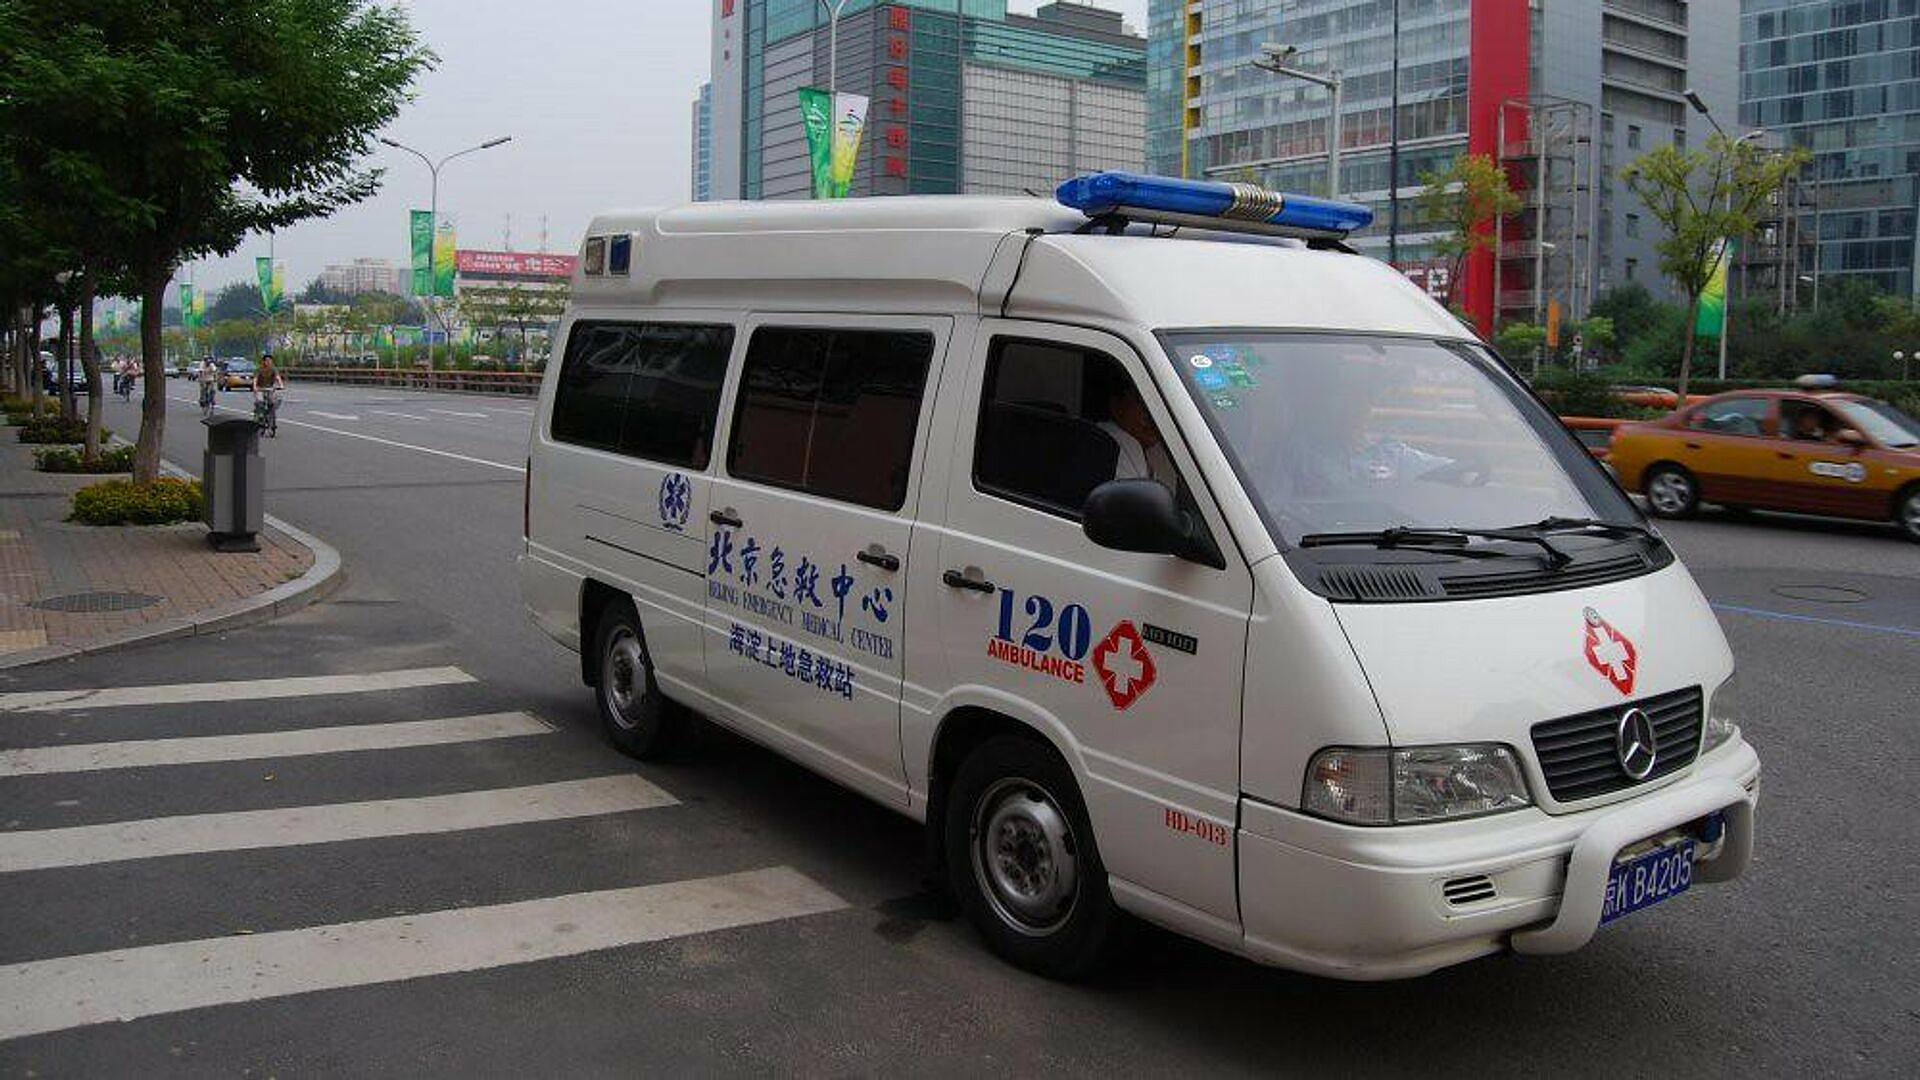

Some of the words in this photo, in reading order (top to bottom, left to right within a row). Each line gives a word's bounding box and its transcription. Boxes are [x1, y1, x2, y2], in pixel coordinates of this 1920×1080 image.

[708, 531, 893, 622] 北京急救中心
[708, 580, 739, 606] BEIJING
[743, 591, 794, 625] EMERGENCY
[802, 612, 844, 644] MEDICAL
[851, 627, 893, 659] CENTER
[994, 587, 1091, 660] 120
[729, 621, 855, 701] 海淀上地急救站
[987, 639, 1085, 683] AMBULANCE
[1164, 808, 1227, 846] HD-013
[1633, 848, 1692, 905] B4205
